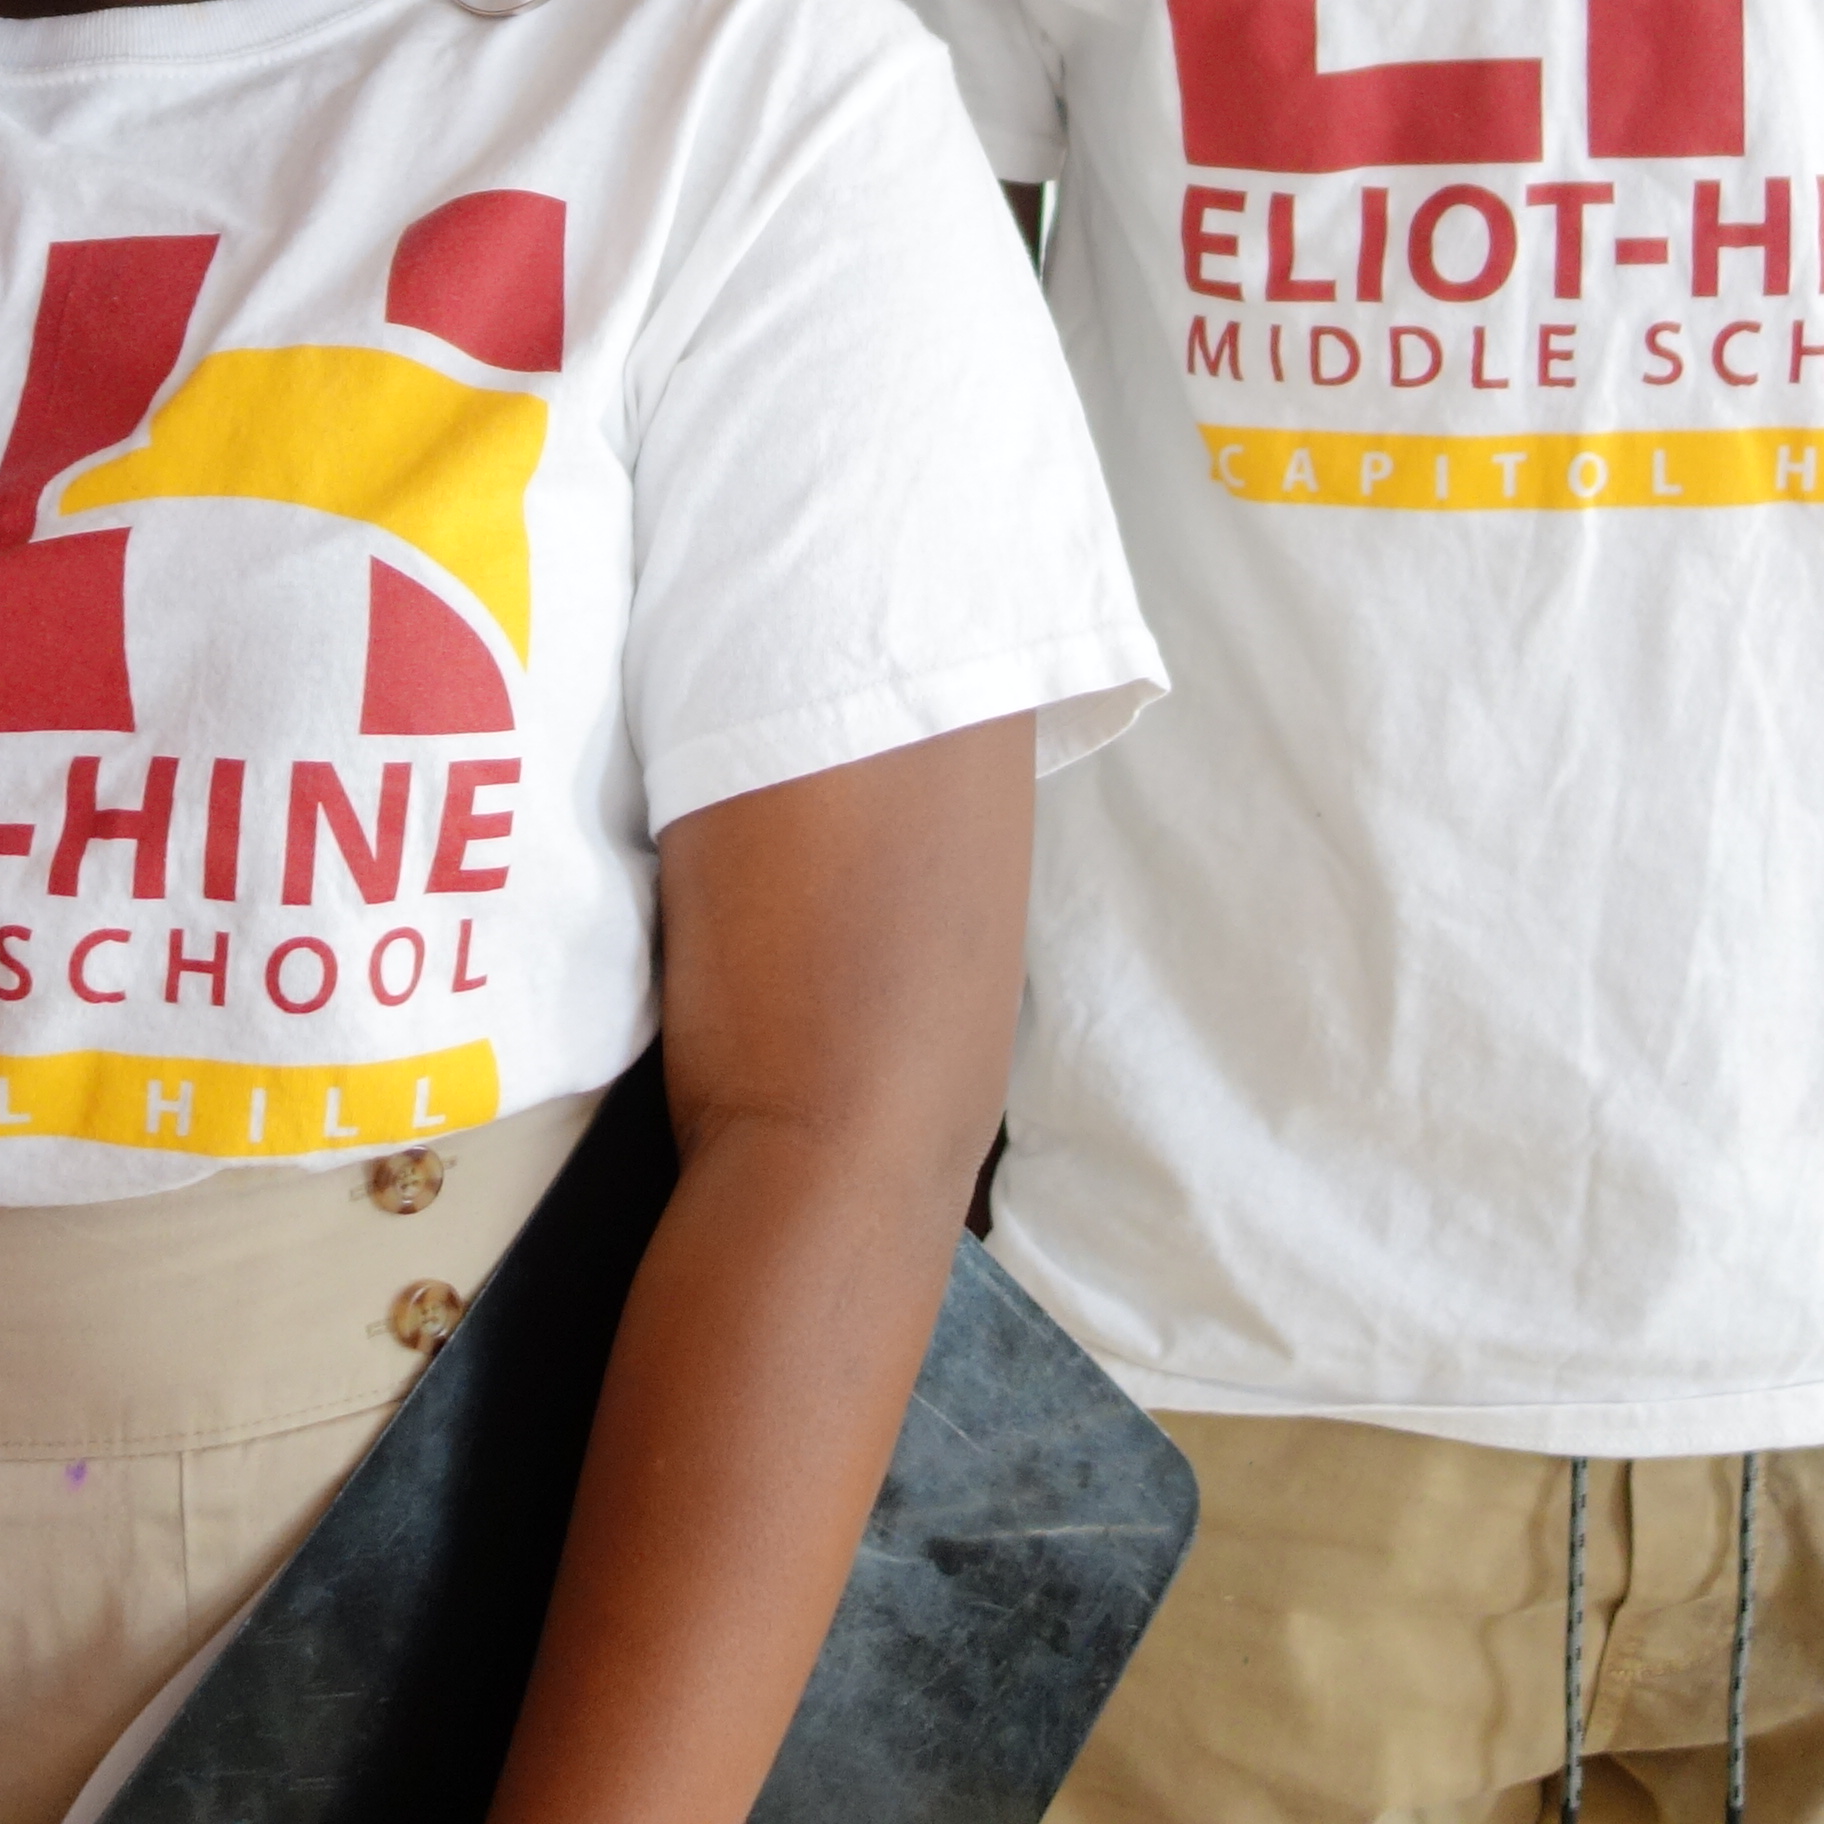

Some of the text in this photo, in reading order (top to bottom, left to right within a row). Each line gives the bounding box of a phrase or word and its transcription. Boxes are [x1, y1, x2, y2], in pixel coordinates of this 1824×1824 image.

[1186, 314, 1578, 390] MIDDLE
[1218, 442, 1684, 500] CAPITOL
[144, 1076, 447, 1145] HILL
